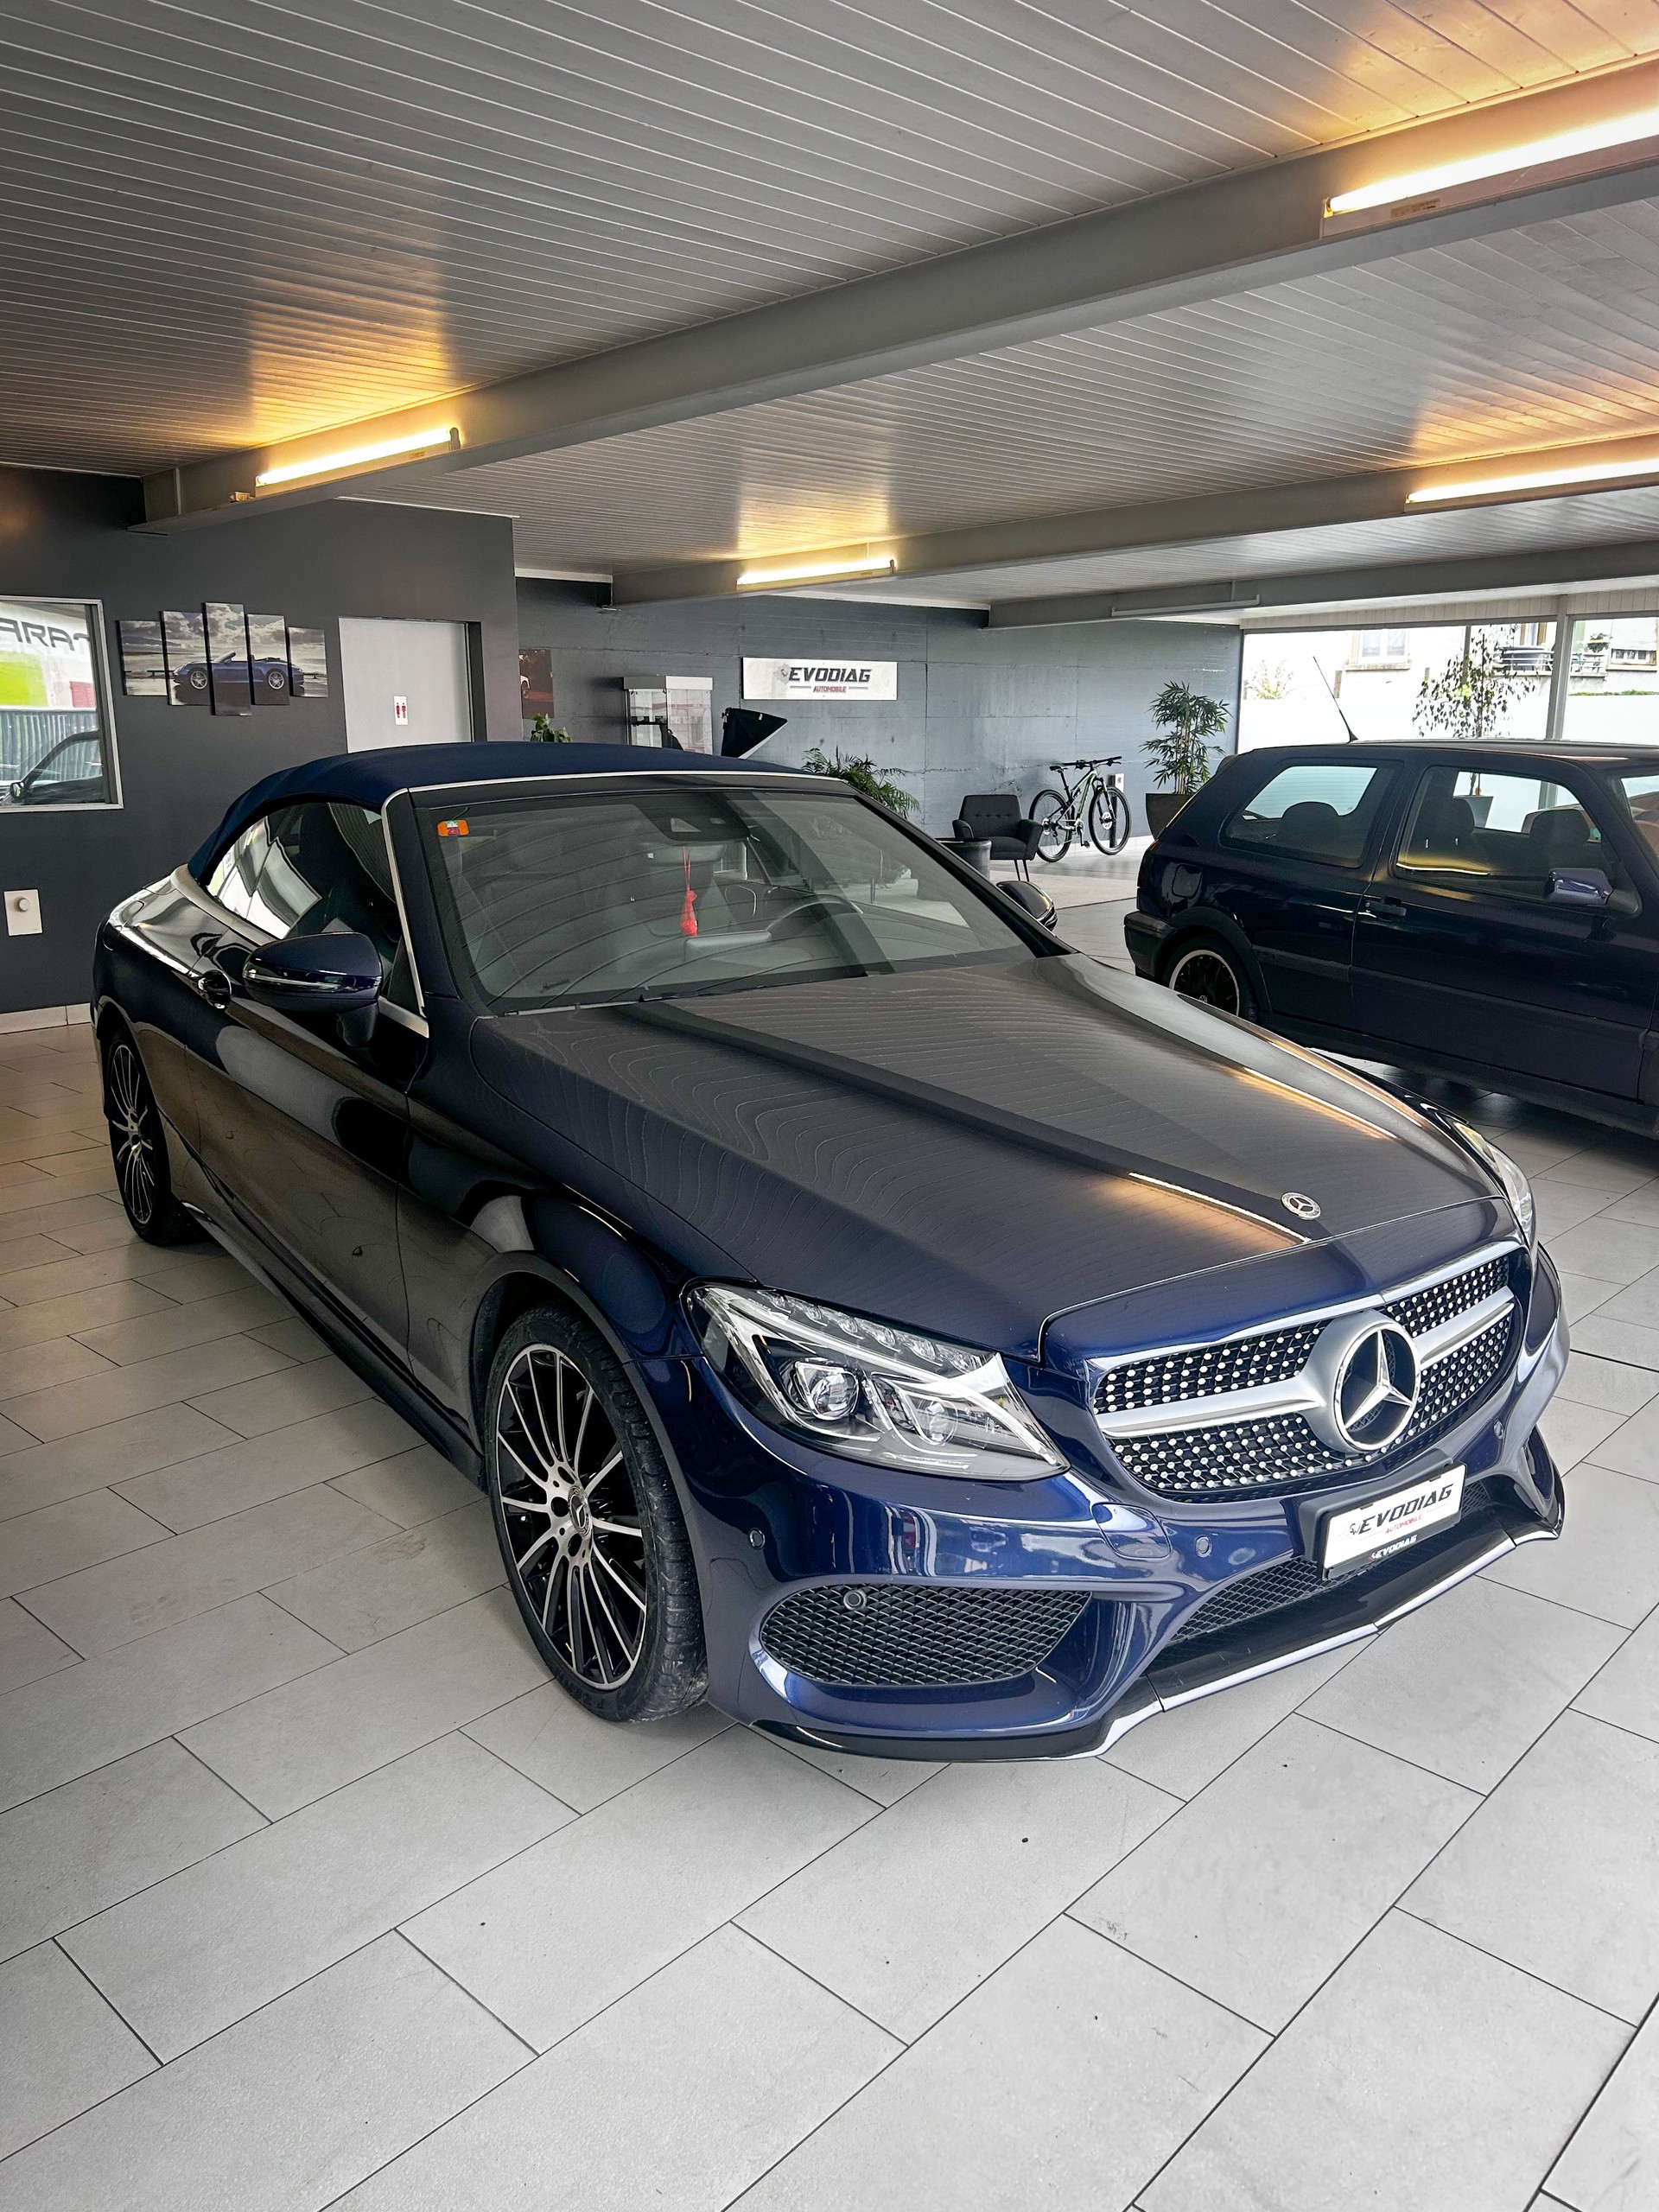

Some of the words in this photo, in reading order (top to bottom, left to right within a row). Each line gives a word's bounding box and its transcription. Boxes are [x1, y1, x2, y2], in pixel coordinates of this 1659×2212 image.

[788, 667, 872, 683] EVODIAG
[813, 685, 847, 694] AUTOMOBILE
[1358, 1483, 1454, 1535] EVODIAG
[1385, 1514, 1422, 1534] AUTOMOBILE
[1375, 1535, 1418, 1559] EVODIAG
